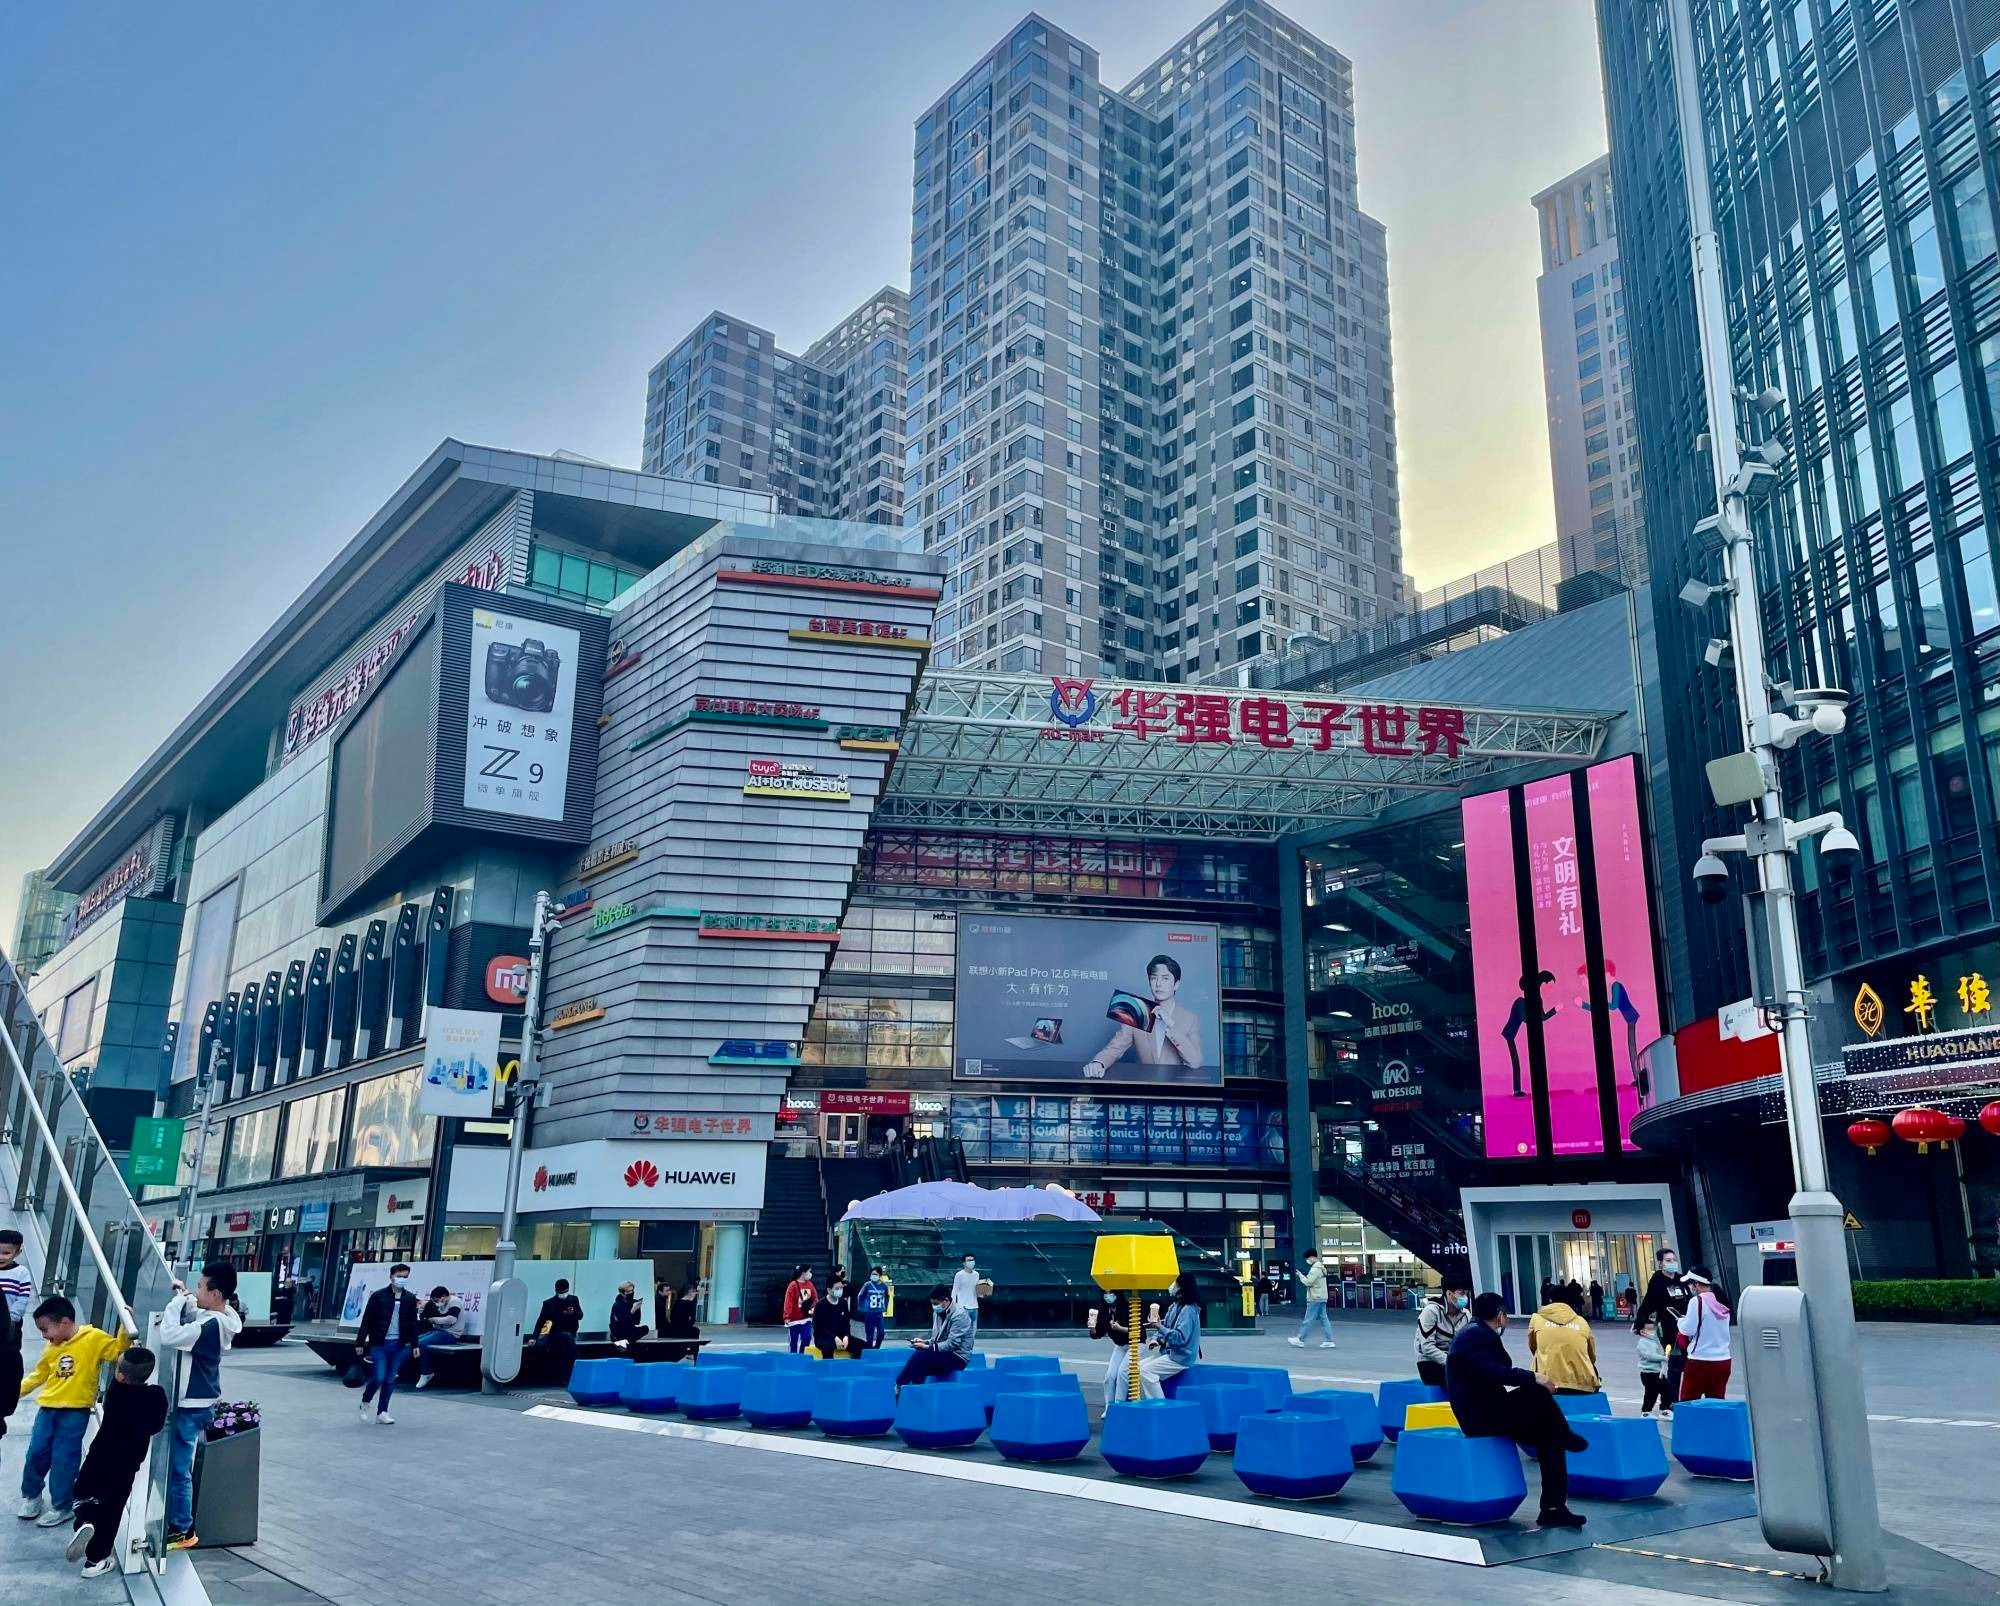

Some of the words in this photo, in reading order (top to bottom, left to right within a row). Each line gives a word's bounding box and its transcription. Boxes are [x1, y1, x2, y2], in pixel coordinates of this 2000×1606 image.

[472, 714, 558, 743] 冲破想象
[1111, 688, 1468, 758] 华强电子世界
[837, 726, 896, 742] acer
[529, 763, 544, 784] 9
[752, 763, 777, 775] tuya
[477, 783, 540, 802] 微单旗舰
[792, 778, 848, 794] MUSEUM
[1552, 836, 1581, 936] 文明有礼
[1030, 967, 1049, 978] Pro
[1371, 1002, 1413, 1020] hoco.
[711, 1041, 787, 1058] ASUS
[837, 1095, 884, 1104] 华强电子世界
[1371, 1090, 1386, 1100] WK
[1388, 1086, 1423, 1099] DESIGN
[654, 1116, 752, 1135] 华强电子世界
[665, 1170, 736, 1185] HUAWEI
